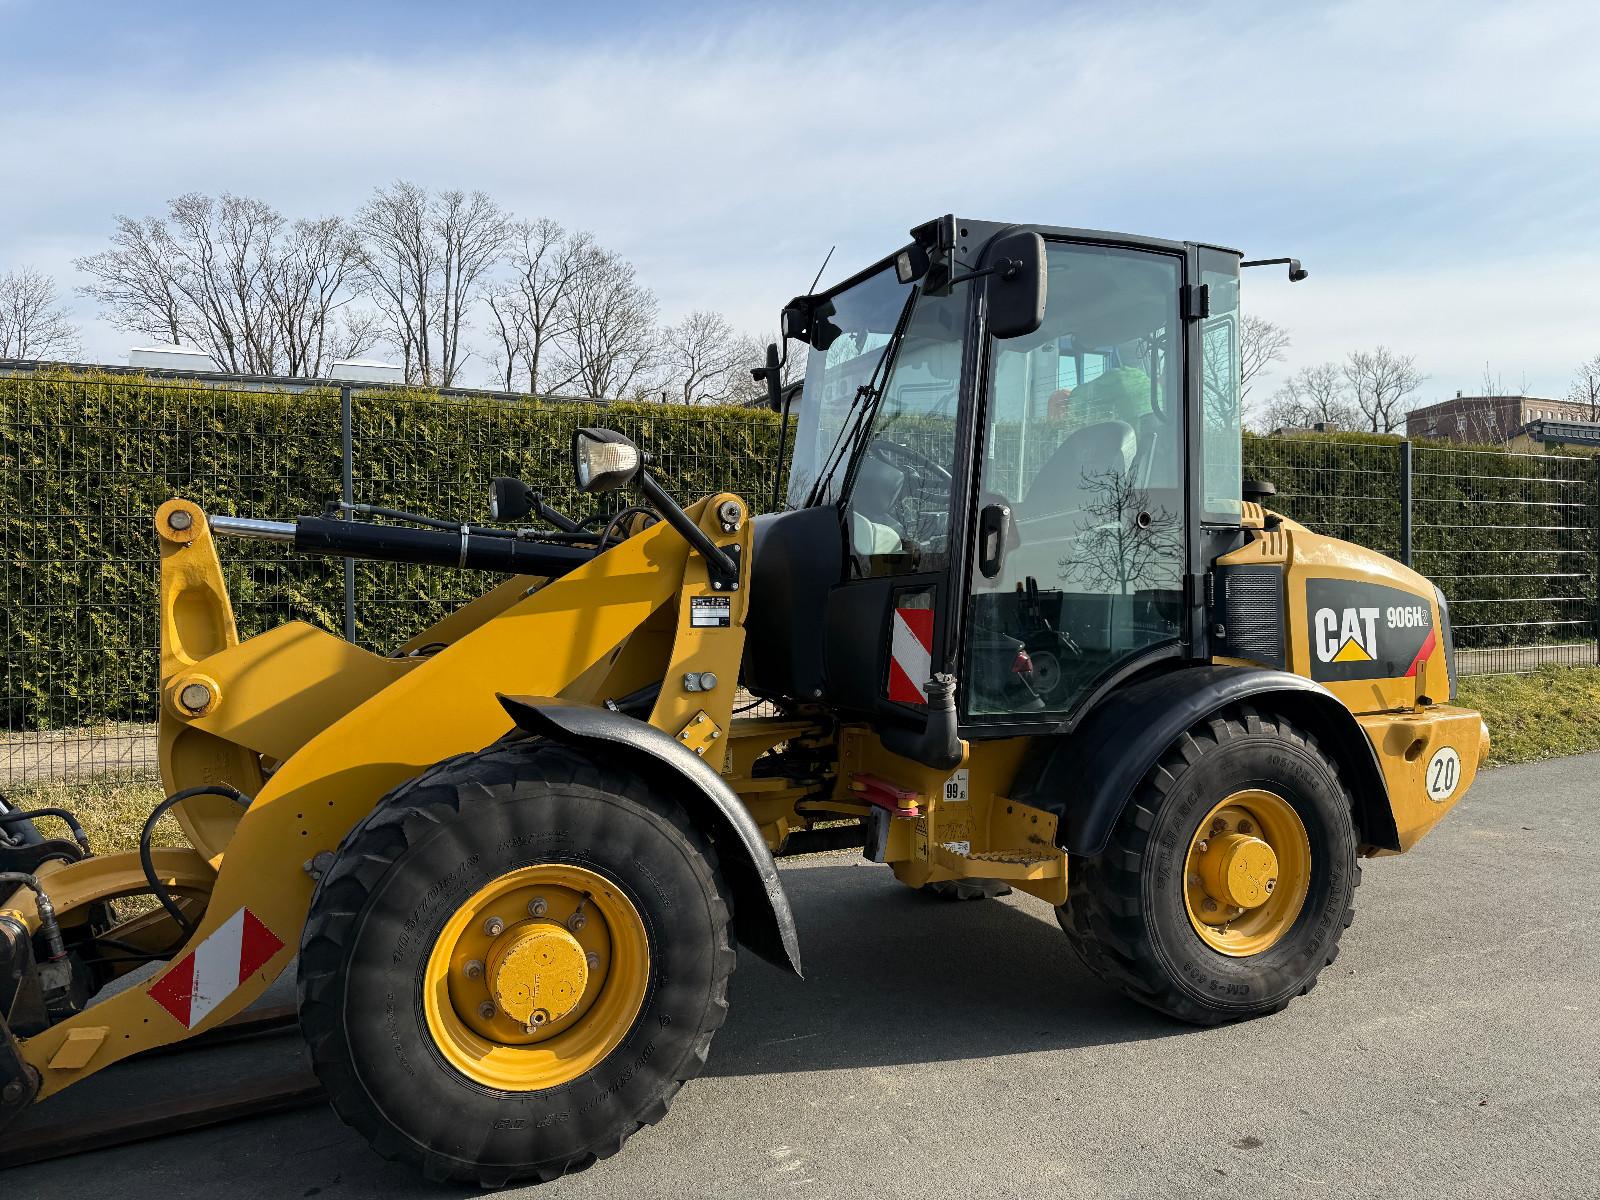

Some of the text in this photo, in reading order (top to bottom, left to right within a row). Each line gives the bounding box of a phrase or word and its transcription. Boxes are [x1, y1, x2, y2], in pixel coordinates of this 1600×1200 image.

[1315, 608, 1380, 663] CAT
[946, 783, 959, 799] 99
[1432, 757, 1455, 792] 20
